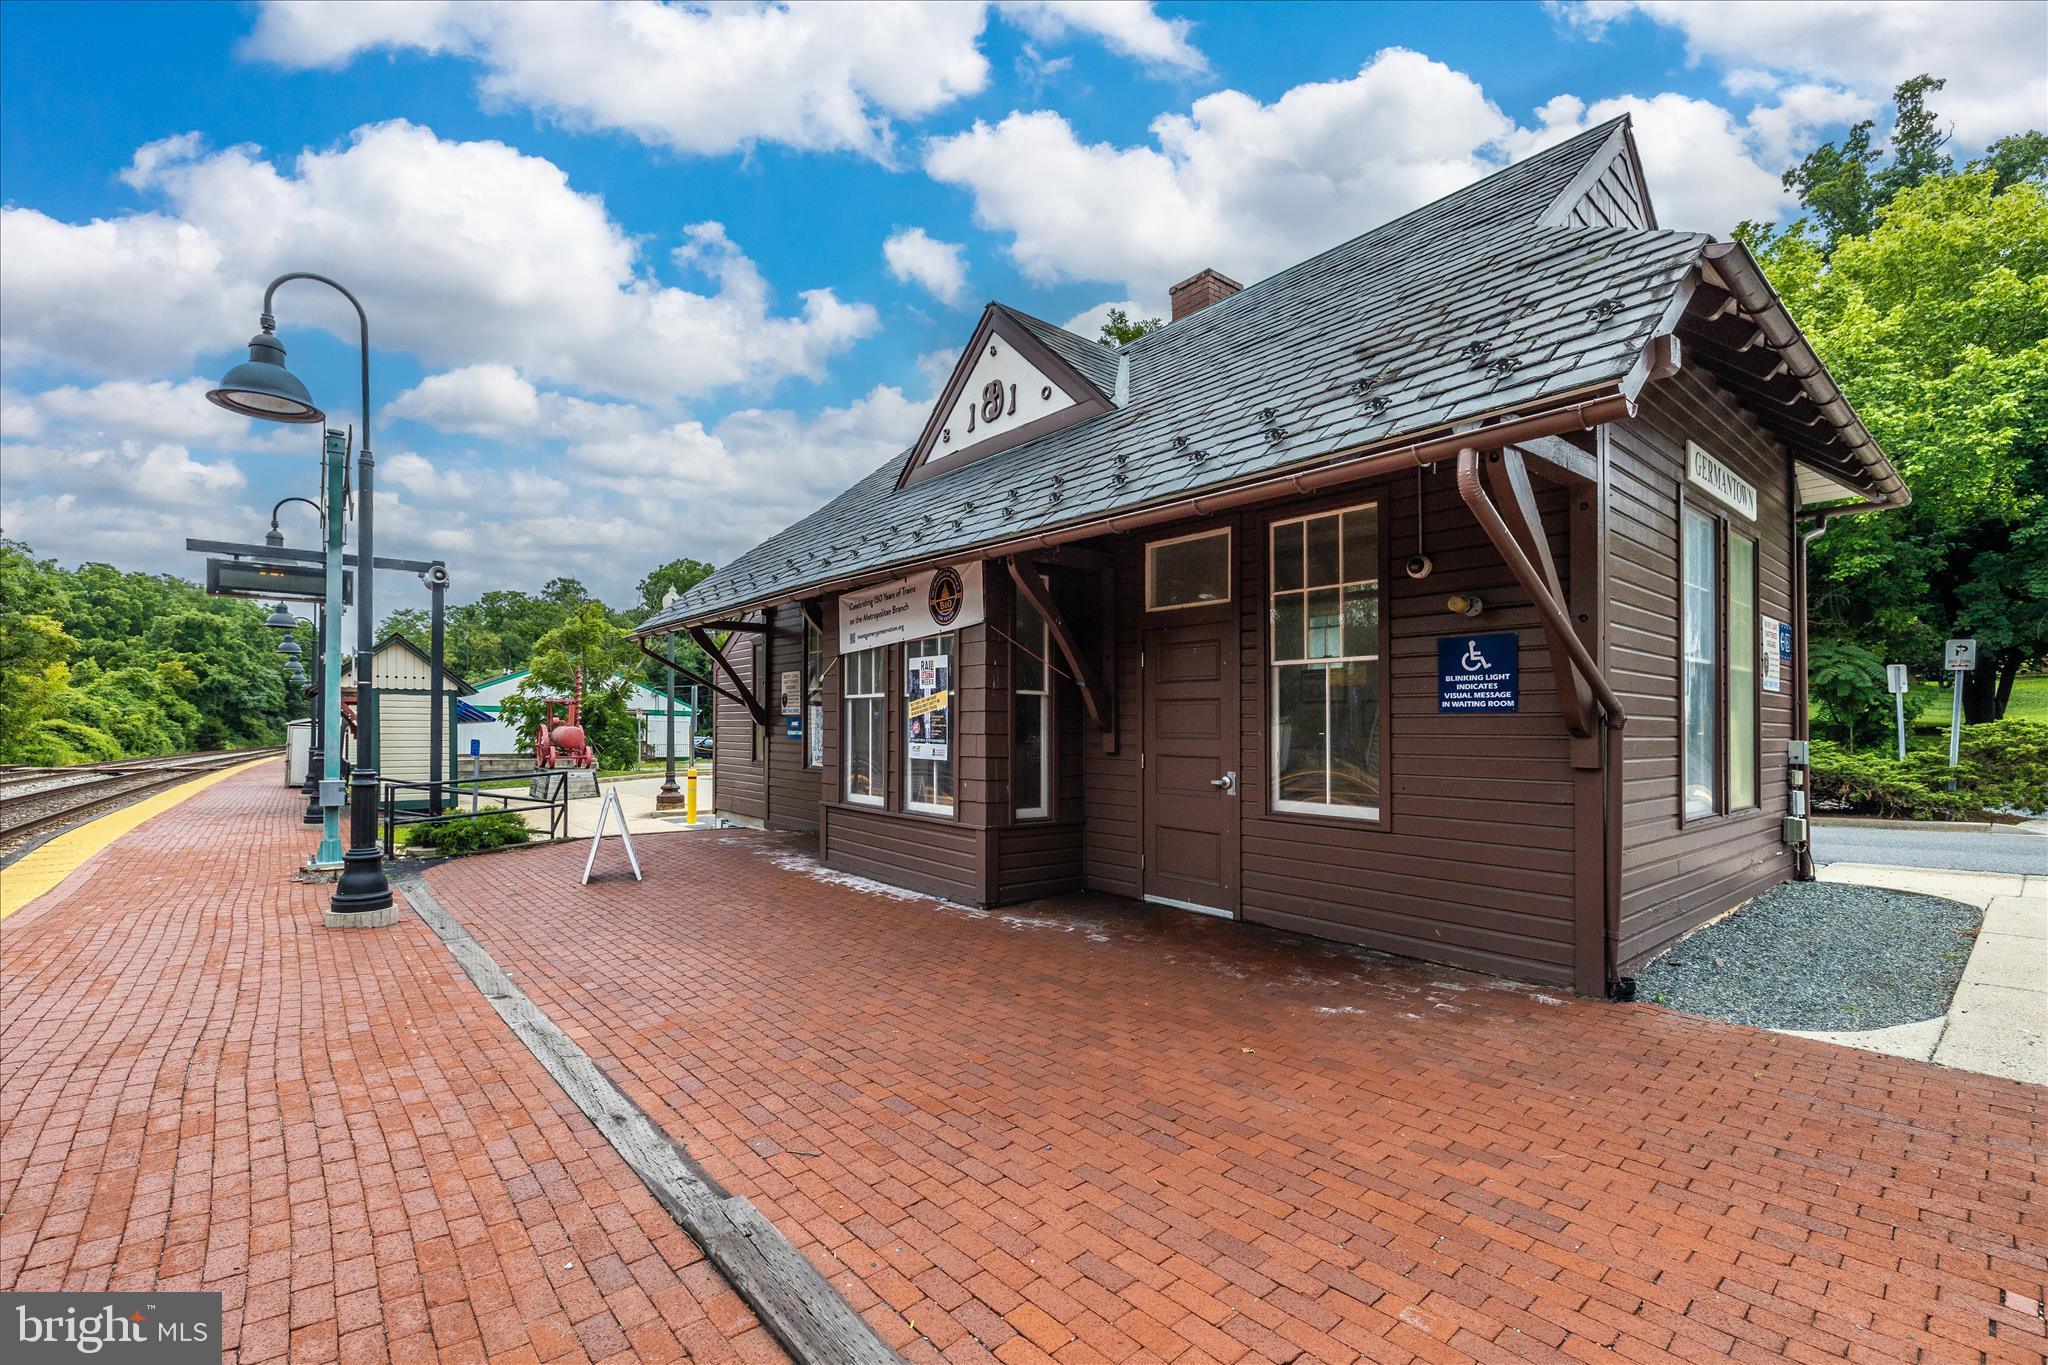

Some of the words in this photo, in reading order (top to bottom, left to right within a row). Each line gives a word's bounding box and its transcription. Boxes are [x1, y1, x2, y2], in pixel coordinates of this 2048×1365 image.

[1695, 451, 1754, 512] GERMANTOWN
[849, 599, 874, 612] Celebrating
[873, 594, 883, 605] 150
[883, 592, 896, 602] Years
[895, 587, 902, 598] of
[901, 585, 917, 596] Trains
[855, 616, 863, 624] the
[863, 608, 892, 622] Metropolitan
[892, 602, 910, 614] Branch
[920, 660, 934, 671] RAIL
[1445, 674, 1484, 682] BLINKING
[1485, 673, 1511, 681] LIGHT
[1456, 682, 1498, 690] INDICATES
[1473, 691, 1512, 699] MESSAGE
